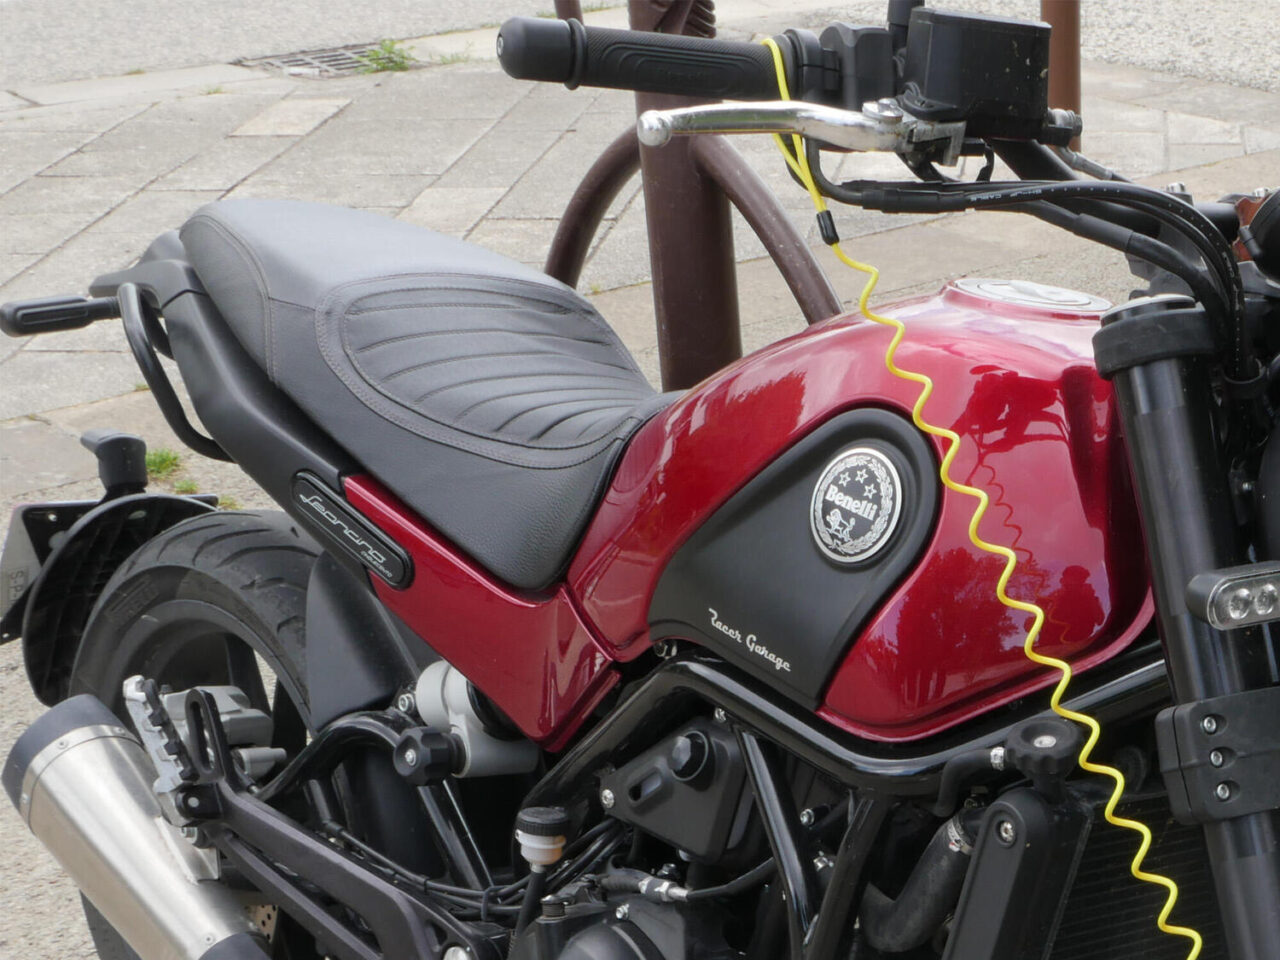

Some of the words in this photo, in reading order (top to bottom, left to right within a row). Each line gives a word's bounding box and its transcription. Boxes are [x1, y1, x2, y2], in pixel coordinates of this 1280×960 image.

[825, 484, 878, 521] Benelli
[708, 607, 742, 643] Racer
[746, 634, 791, 672] Garage
